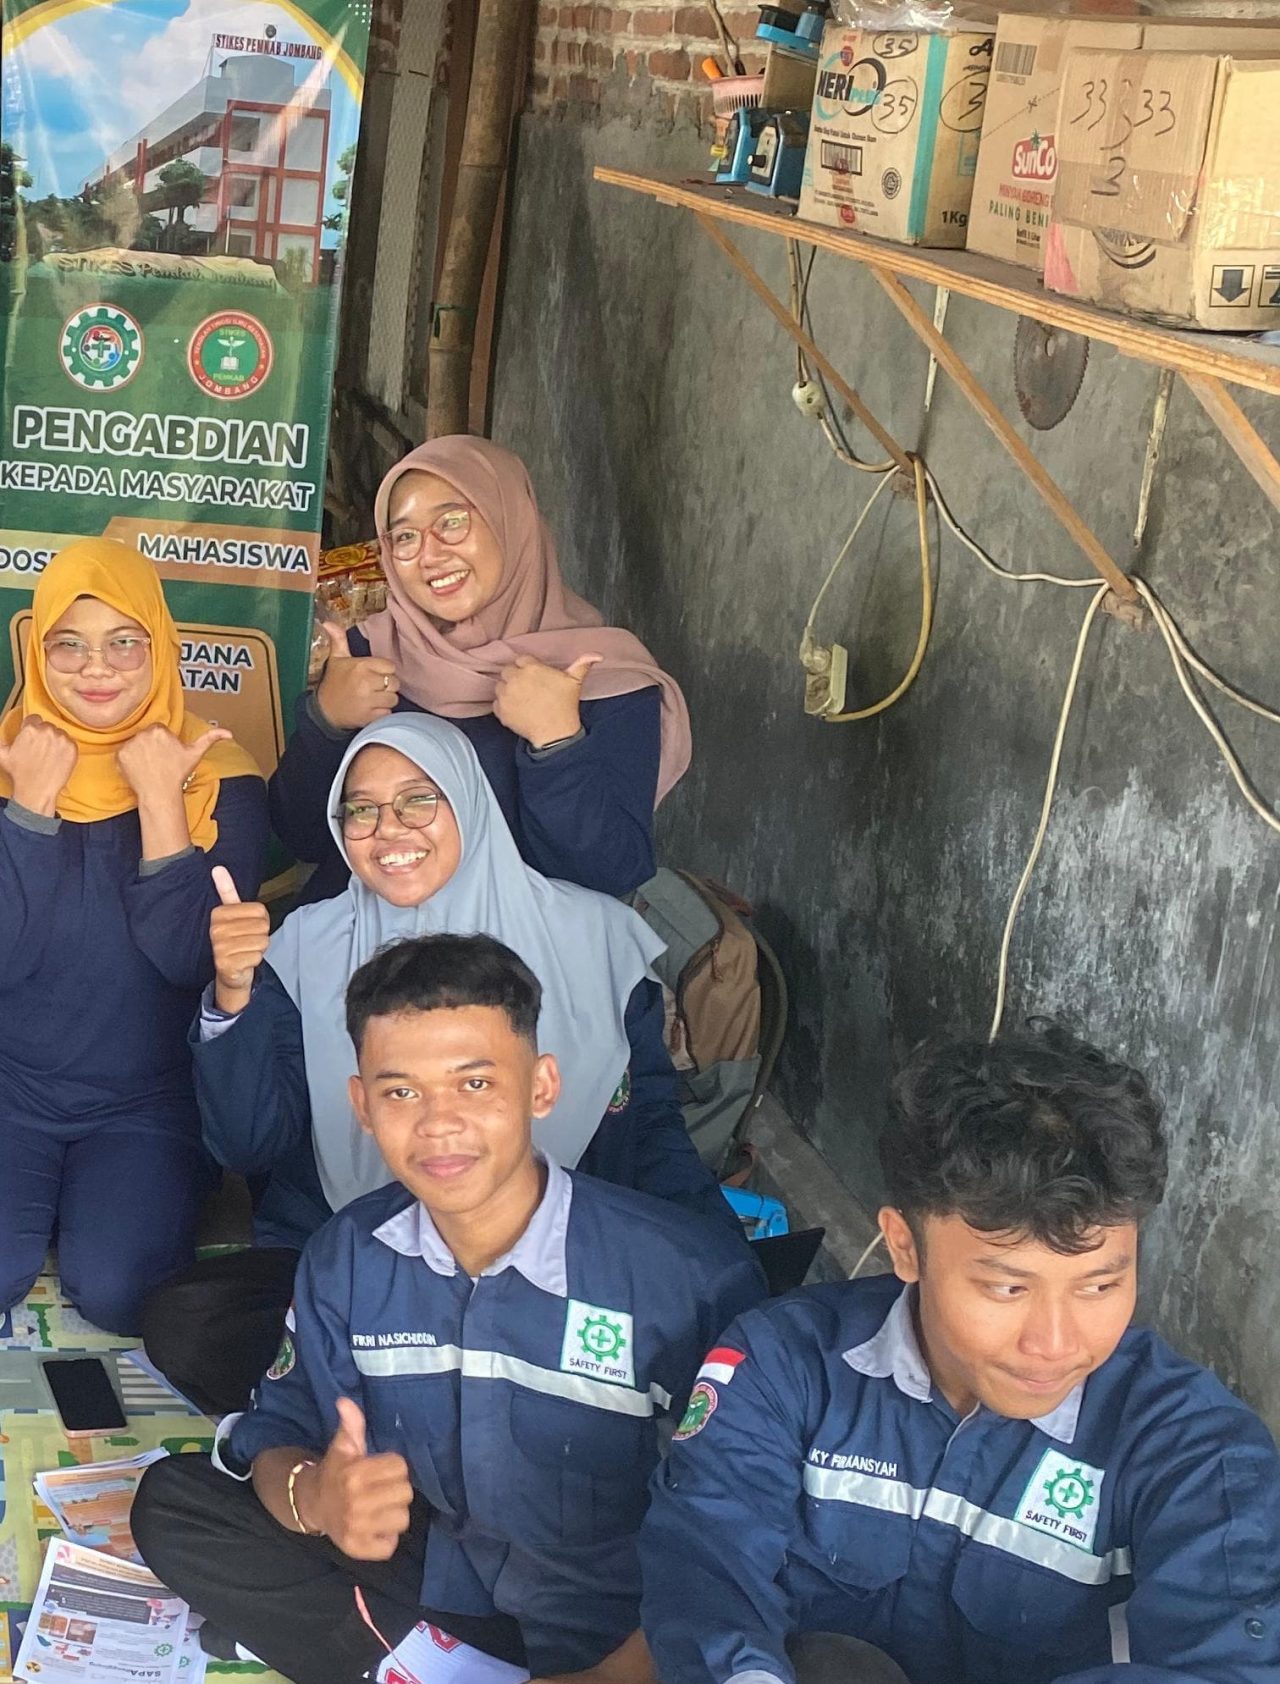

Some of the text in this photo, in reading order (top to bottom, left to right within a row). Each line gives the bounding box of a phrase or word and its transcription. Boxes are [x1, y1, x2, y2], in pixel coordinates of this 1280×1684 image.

[215, 34, 245, 51] STIKES
[283, 42, 323, 60] JOMBANG
[883, 38, 914, 54] 35
[878, 92, 915, 121] 35
[1013, 139, 1056, 176] SunCo
[941, 210, 968, 227] 1Kg
[989, 200, 1021, 221] PALING
[198, 374, 260, 395] JOMBANG
[14, 406, 308, 467] PENGABDIAN
[0, 462, 314, 511] KEPADA MASYARAKAT
[138, 534, 312, 574] MAHASISWA
[569, 1357, 628, 1380] SAFETY FIRST
[1025, 1509, 1088, 1543] SAFETY FIRST
